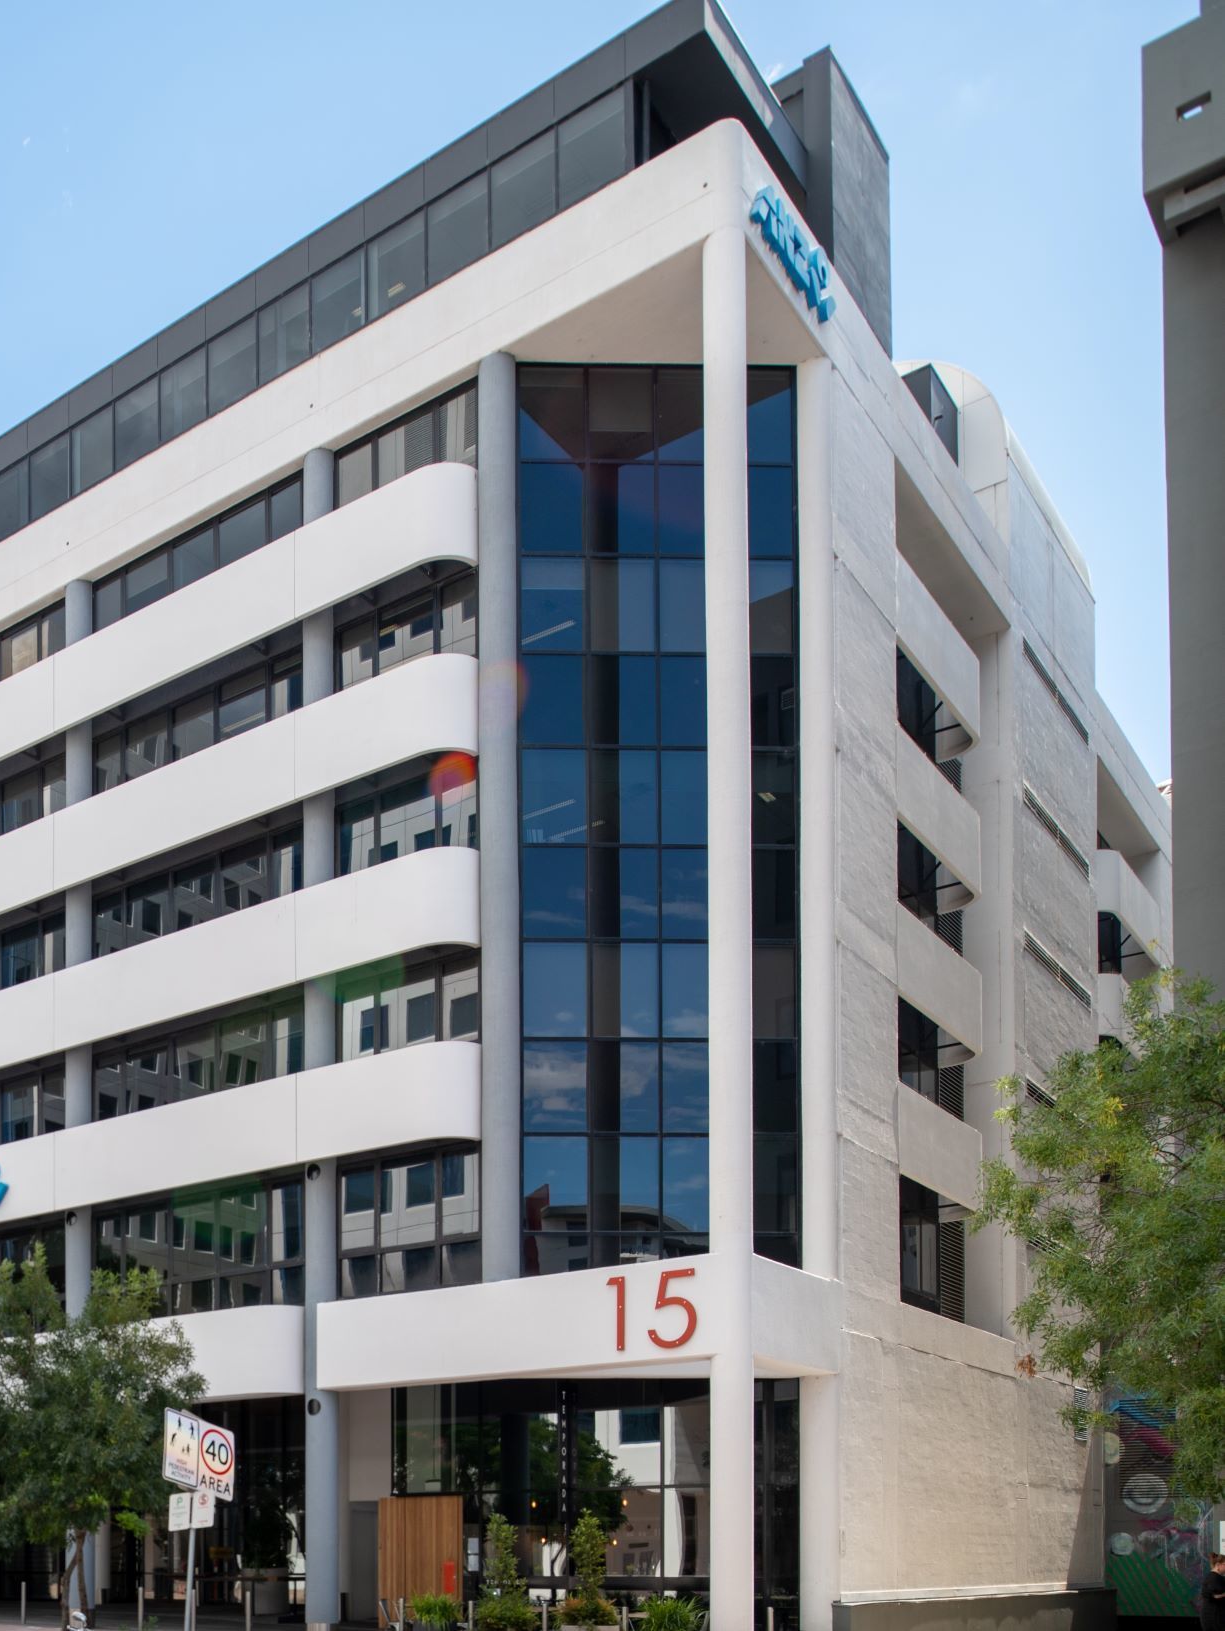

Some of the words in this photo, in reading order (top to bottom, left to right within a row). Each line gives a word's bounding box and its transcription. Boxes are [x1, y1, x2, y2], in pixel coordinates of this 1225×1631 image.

[750, 185, 811, 292] ANZ
[606, 1267, 697, 1351] 15
[205, 1440, 229, 1466] 40
[199, 1474, 231, 1497] AREA
